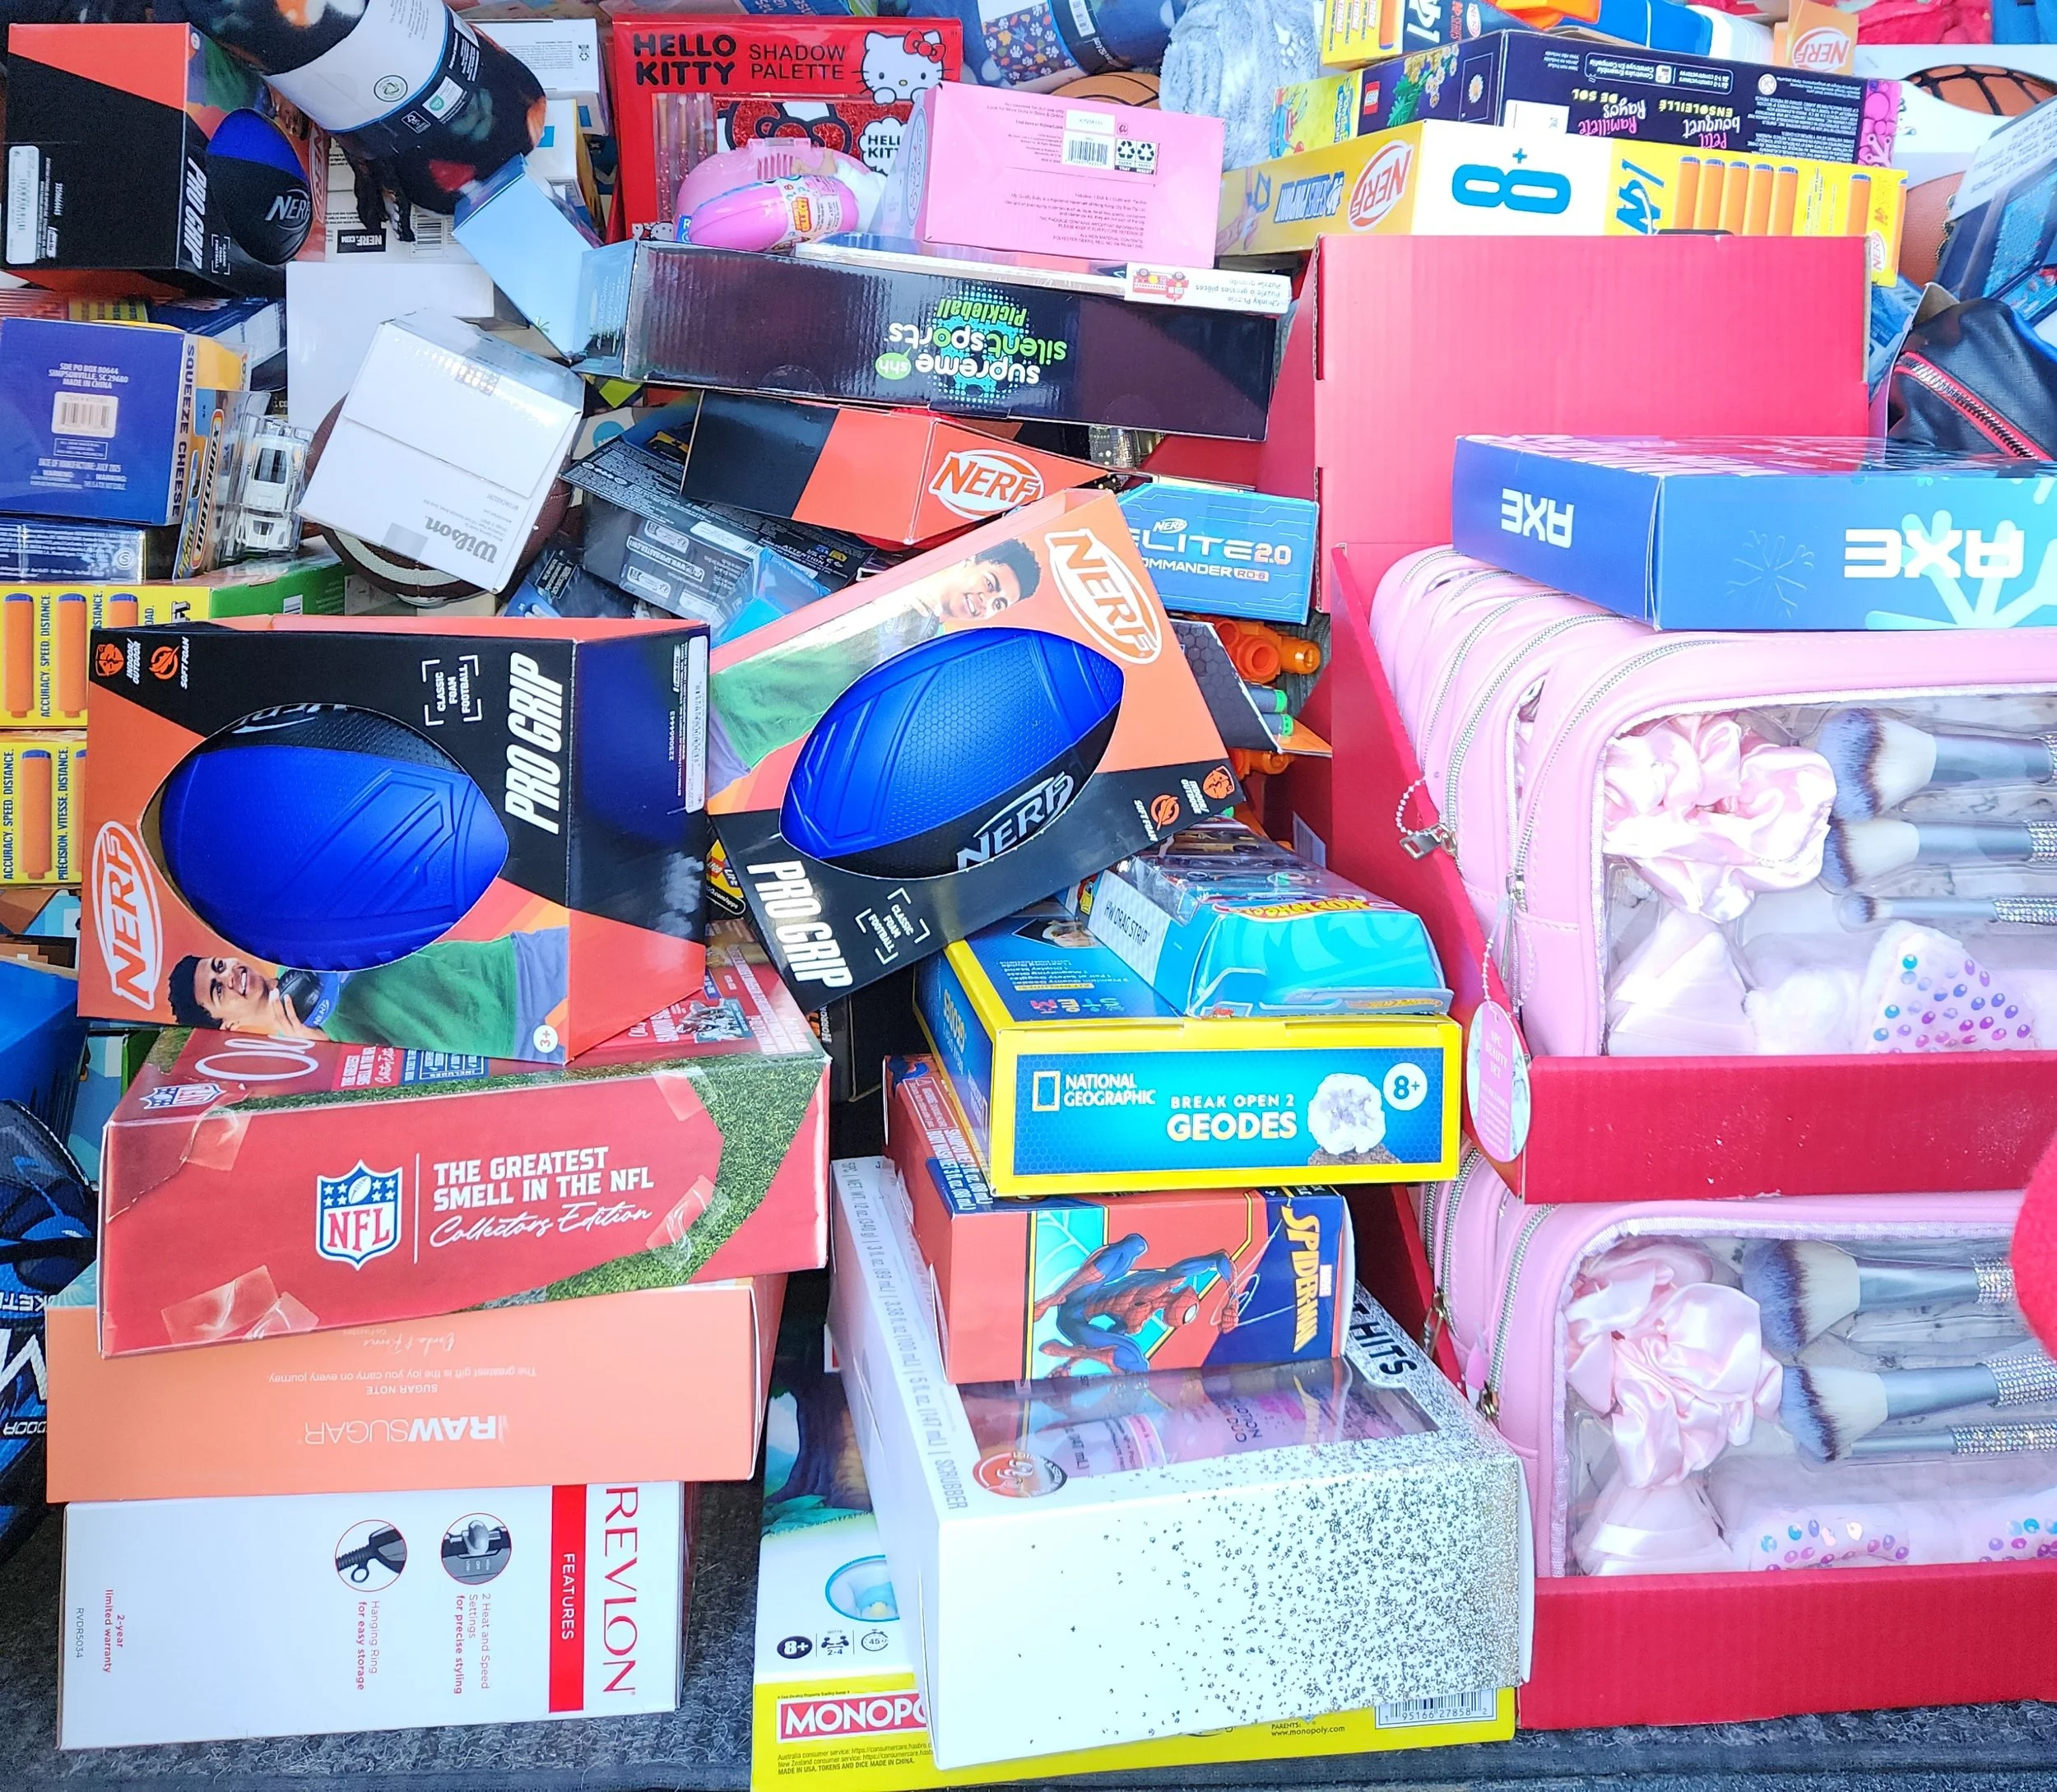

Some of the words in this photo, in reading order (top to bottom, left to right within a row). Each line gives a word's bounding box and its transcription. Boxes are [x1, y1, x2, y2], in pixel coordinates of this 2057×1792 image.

[633, 34, 736, 57] HELLO
[749, 44, 846, 61] SHADOW
[1795, 40, 1849, 63] NERF
[636, 62, 735, 86] KITTY
[751, 64, 845, 80] PALETTE
[1572, 89, 1597, 101] SOL
[1600, 93, 1618, 103] DE
[1604, 97, 1646, 119] Rayos
[1659, 100, 1733, 117] ENSOLEILLÉ
[1578, 116, 1637, 137] Ramillete
[1683, 115, 1740, 138] bouquet
[1699, 132, 1726, 149] Petit
[186, 157, 207, 216] PRO
[1350, 150, 1411, 220] NERF
[1452, 148, 1572, 214] 8+
[265, 196, 310, 221] NERF
[184, 206, 203, 269] GRIP
[341, 234, 382, 246] NERF.COM
[937, 299, 1027, 326] Pickleball
[84, 364, 97, 373] BOX
[878, 360, 909, 373] shh
[916, 353, 1041, 384] supreme
[63, 378, 82, 387] MADE
[180, 344, 194, 434] SQUEEZE
[172, 442, 187, 518] CHEESE
[197, 423, 220, 551] MATCHBOX
[935, 457, 1041, 504] NERF
[1154, 518, 1187, 533] NERF
[1502, 489, 1574, 549] AXE
[425, 515, 498, 564] Wilson
[1844, 529, 2026, 578] AXE
[1255, 544, 1292, 565] 2.0
[1140, 560, 1233, 578] OMMANDER
[1046, 532, 1157, 660] NERF
[132, 641, 142, 685] OUTDOOR
[181, 637, 189, 663] FOAM
[180, 664, 189, 689] SOFT
[448, 676, 457, 704] FOAM
[461, 663, 470, 713] FOOTBALL
[437, 671, 446, 712] CLASSIC
[508, 652, 563, 753] GRIP
[3, 749, 14, 793] DISTANCE.
[57, 746, 69, 791] DISTANCE.
[505, 745, 561, 835] PRO
[1181, 778, 1202, 815] OUTDOOR
[1189, 779, 1210, 814] INDOOR/
[3, 795, 13, 827] SPEED.
[57, 794, 68, 830] VITESSE.
[956, 771, 1072, 871] NERF
[1134, 799, 1149, 820] SOFT
[1142, 819, 1159, 843] FOAM
[3, 829, 13, 880] ACCURACY.
[57, 833, 68, 881] PRÉCISION.
[708, 861, 722, 874] LEGO
[723, 868, 738, 887] LIFE
[746, 861, 822, 919] PRO
[104, 829, 153, 1007] NERF
[883, 914, 902, 939] FOAM
[891, 904, 914, 936] CLASSIC
[1104, 901, 1114, 921] HW
[1114, 908, 1130, 931] DRAG
[1128, 921, 1147, 947] STRIP
[867, 914, 895, 954] FOOTBALL
[775, 922, 853, 987] GRIP
[539, 1028, 555, 1049] 3+
[1485, 1041, 1507, 1068] BEAUTY
[1066, 1074, 1137, 1090] NATIONAL
[1394, 1075, 1421, 1098] 8+
[1064, 1089, 1156, 1107] GEOGRAPHIC
[1171, 1095, 1226, 1110] BREAK
[1233, 1094, 1279, 1109] OPEN
[1285, 1093, 1294, 1107] 2
[1167, 1112, 1298, 1142] GEODES
[433, 1163, 481, 1186] THE
[490, 1146, 609, 1179] GREATEST
[433, 1184, 513, 1212] SMELL
[522, 1178, 547, 1202] IN
[557, 1171, 601, 1198] THE
[611, 1166, 655, 1192] NFL
[327, 1207, 392, 1253] NFL
[430, 1211, 554, 1248] Collectors
[558, 1200, 653, 1232] Edition
[1350, 1321, 1418, 1375] HITS
[267, 1372, 308, 1383] journey.
[310, 1372, 337, 1381] every
[355, 1372, 382, 1381] carry
[385, 1372, 403, 1381] you
[406, 1370, 422, 1379] joy
[425, 1369, 441, 1378] the
[443, 1369, 453, 1377] is
[454, 1367, 471, 1379] gift
[474, 1367, 514, 1377] greatest
[516, 1367, 537, 1377] The
[366, 1386, 396, 1395] NOTE
[399, 1384, 438, 1394] SUGAR
[935, 1459, 968, 1510] SCRUBBER
[456, 1595, 465, 1609] for
[561, 1553, 575, 1641] FEATURES
[602, 1486, 638, 1692] REVLON
[105, 1590, 114, 1625] limited
[359, 1602, 367, 1616] for
[468, 1595, 478, 1639] Settings
[482, 1604, 490, 1627] Heat
[76, 1608, 84, 1659] RVDR5034
[116, 1614, 125, 1649] 2-year
[357, 1620, 366, 1646] easy
[370, 1601, 379, 1646] Hanging
[454, 1613, 464, 1654] precise
[103, 1628, 112, 1674] warranty
[369, 1650, 378, 1674] Ring
[784, 1641, 809, 1655] 8+
[357, 1650, 366, 1690] storage
[454, 1657, 463, 1694] styling
[481, 1655, 490, 1689] Speed
[1402, 1710, 1434, 1720] 95166
[1439, 1707, 1471, 1718] 27858
[1271, 1725, 1345, 1737] www.monopoly.com
[778, 1753, 801, 1761] Australia
